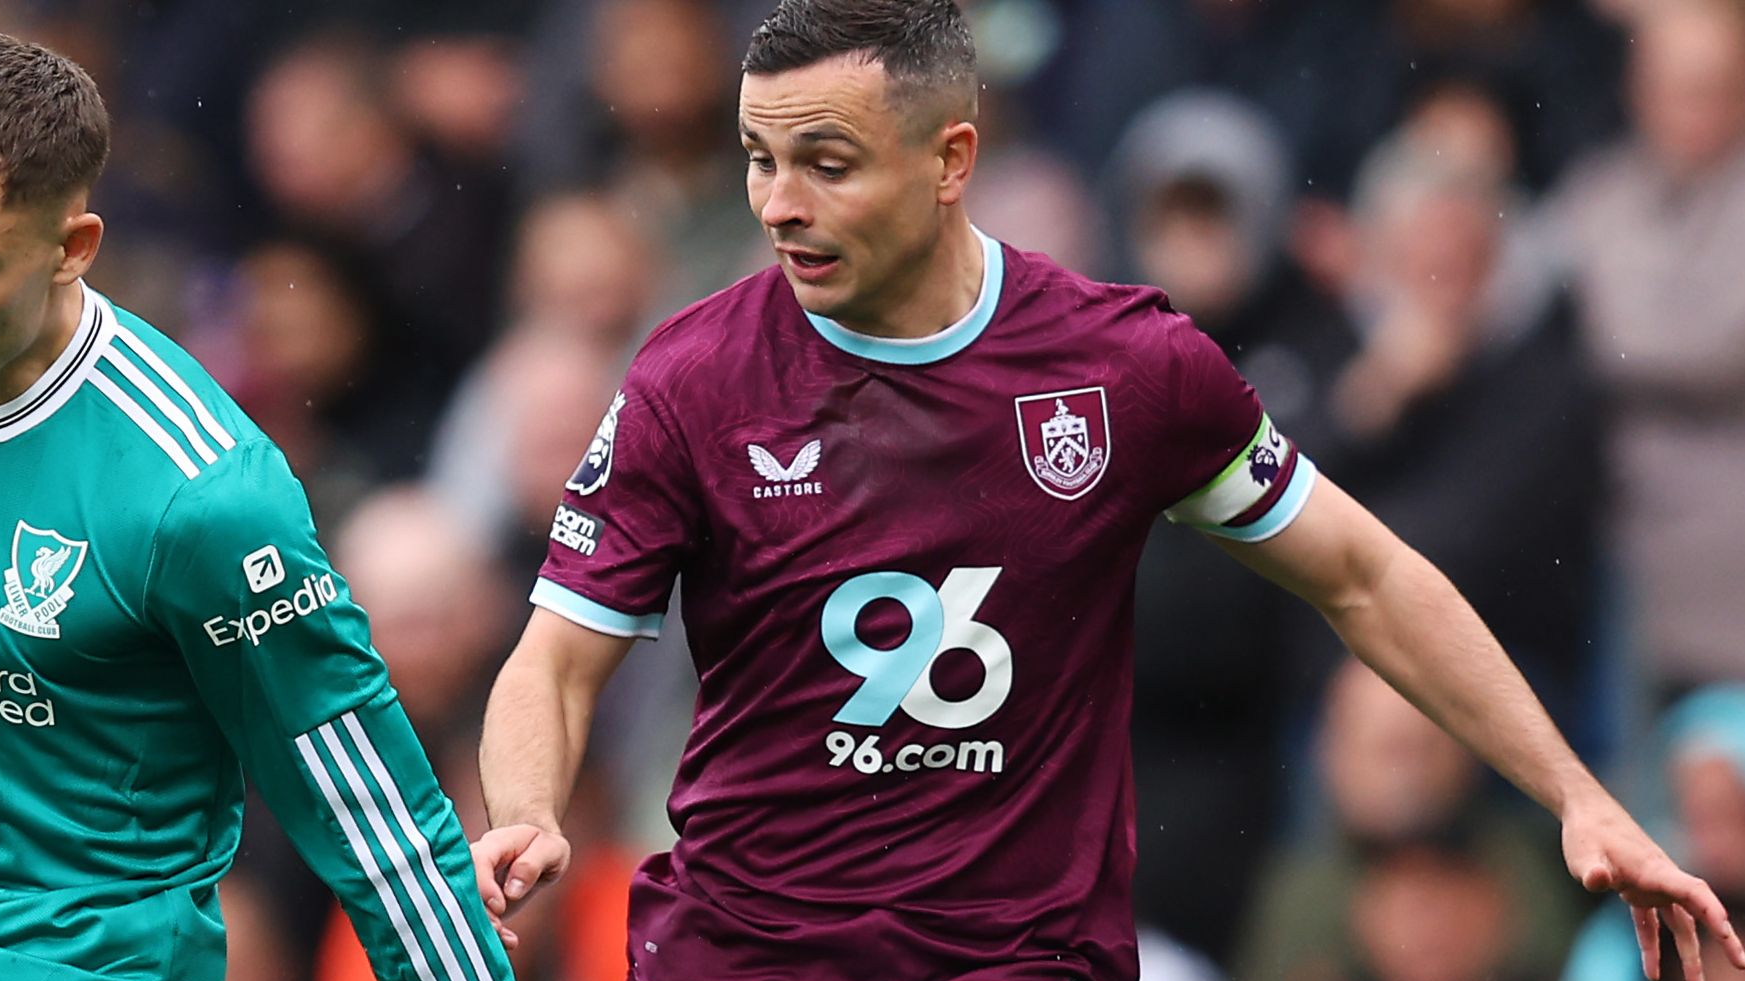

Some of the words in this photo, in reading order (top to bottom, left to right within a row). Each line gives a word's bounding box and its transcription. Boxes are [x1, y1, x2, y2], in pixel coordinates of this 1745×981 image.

[753, 482, 823, 498] CASTORE
[8, 583, 28, 618] LIVER
[33, 594, 63, 622] POOL
[202, 573, 338, 647] Expedia
[0, 611, 36, 634] FOOTBALL
[37, 625, 58, 636] CLUB
[820, 565, 1013, 730] 96
[825, 730, 1005, 775] 96.com
